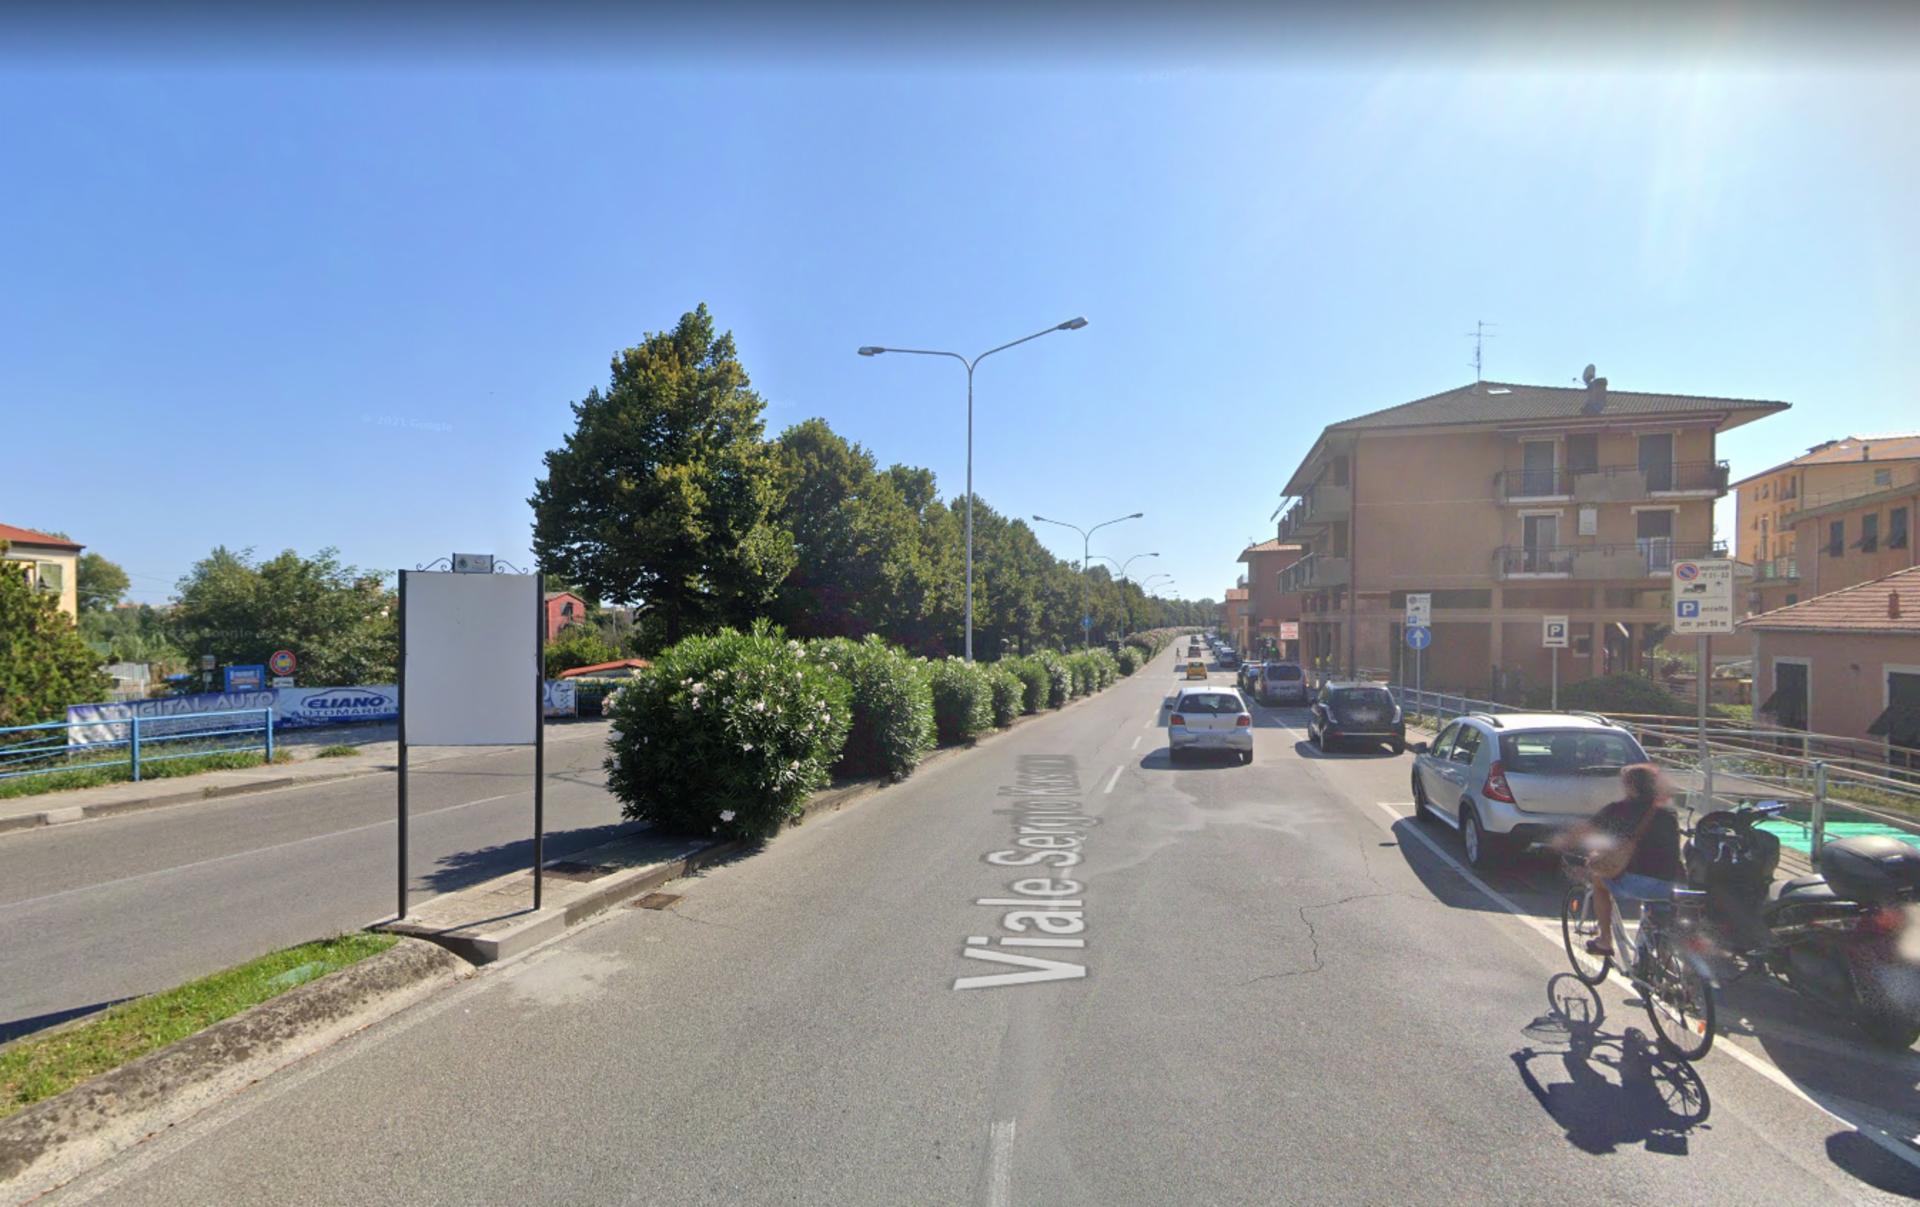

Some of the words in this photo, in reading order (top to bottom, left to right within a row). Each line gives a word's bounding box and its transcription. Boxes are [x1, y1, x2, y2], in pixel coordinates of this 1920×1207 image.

[112, 697, 208, 719] DIGITAL
[213, 692, 275, 709] AUTO
[307, 696, 385, 709] ELIANO
